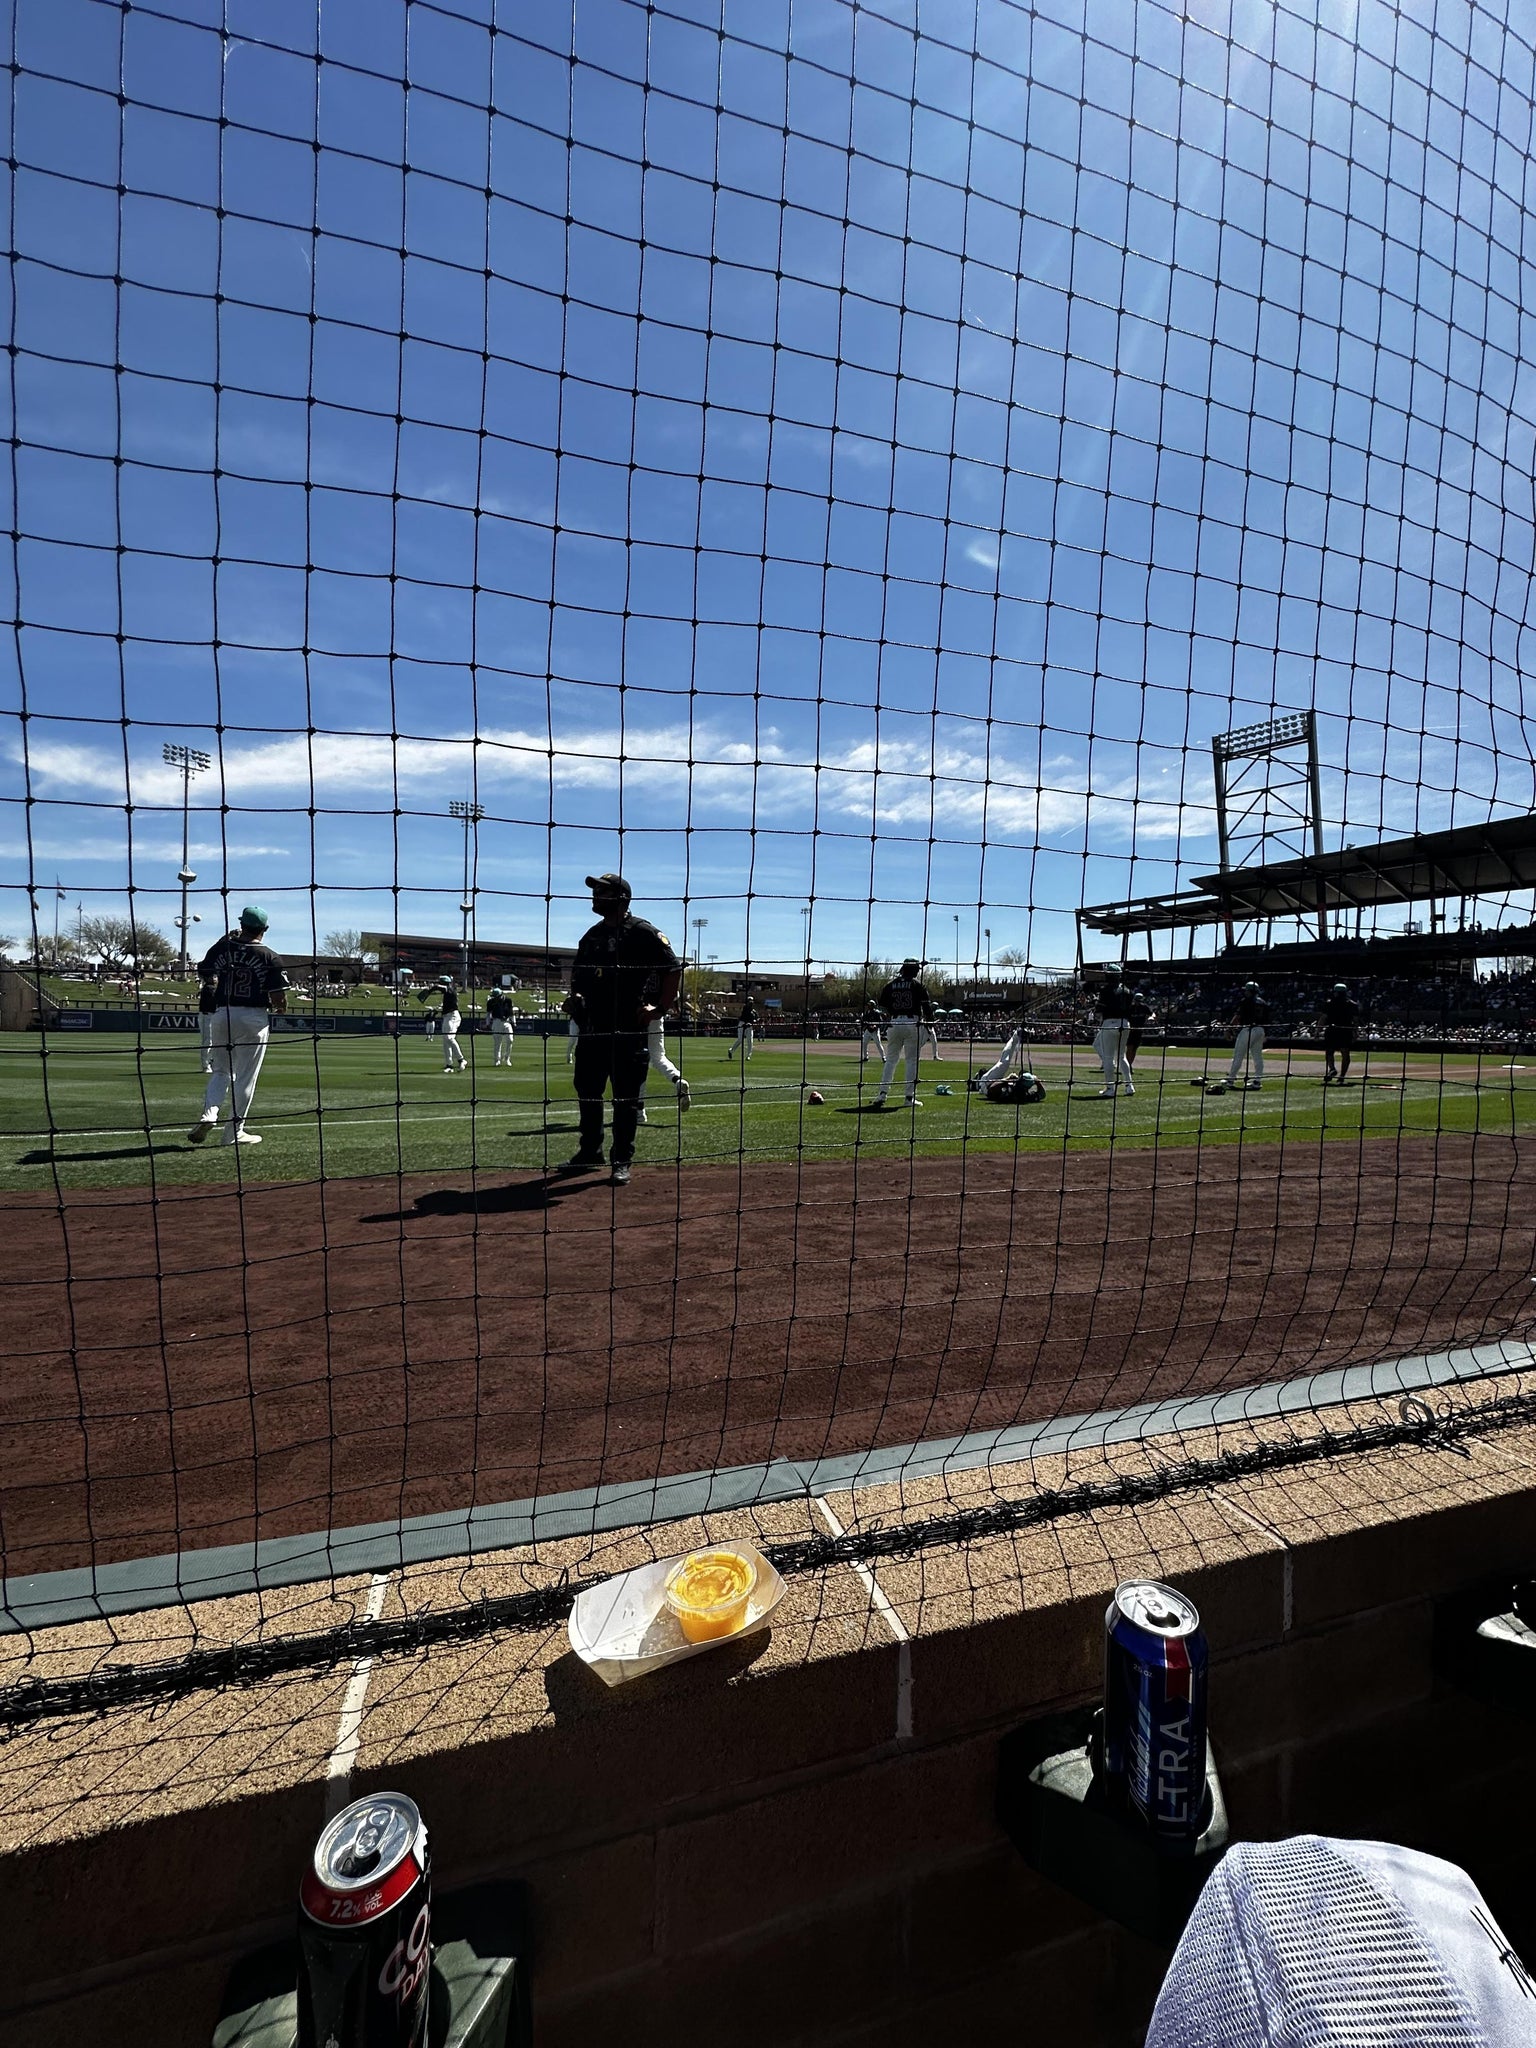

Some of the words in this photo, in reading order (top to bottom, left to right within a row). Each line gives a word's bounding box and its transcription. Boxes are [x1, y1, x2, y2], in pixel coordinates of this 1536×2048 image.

[891, 990, 913, 1010] 33
[157, 1015, 197, 1028] AVN
[329, 1897, 361, 1919] 7.2%
